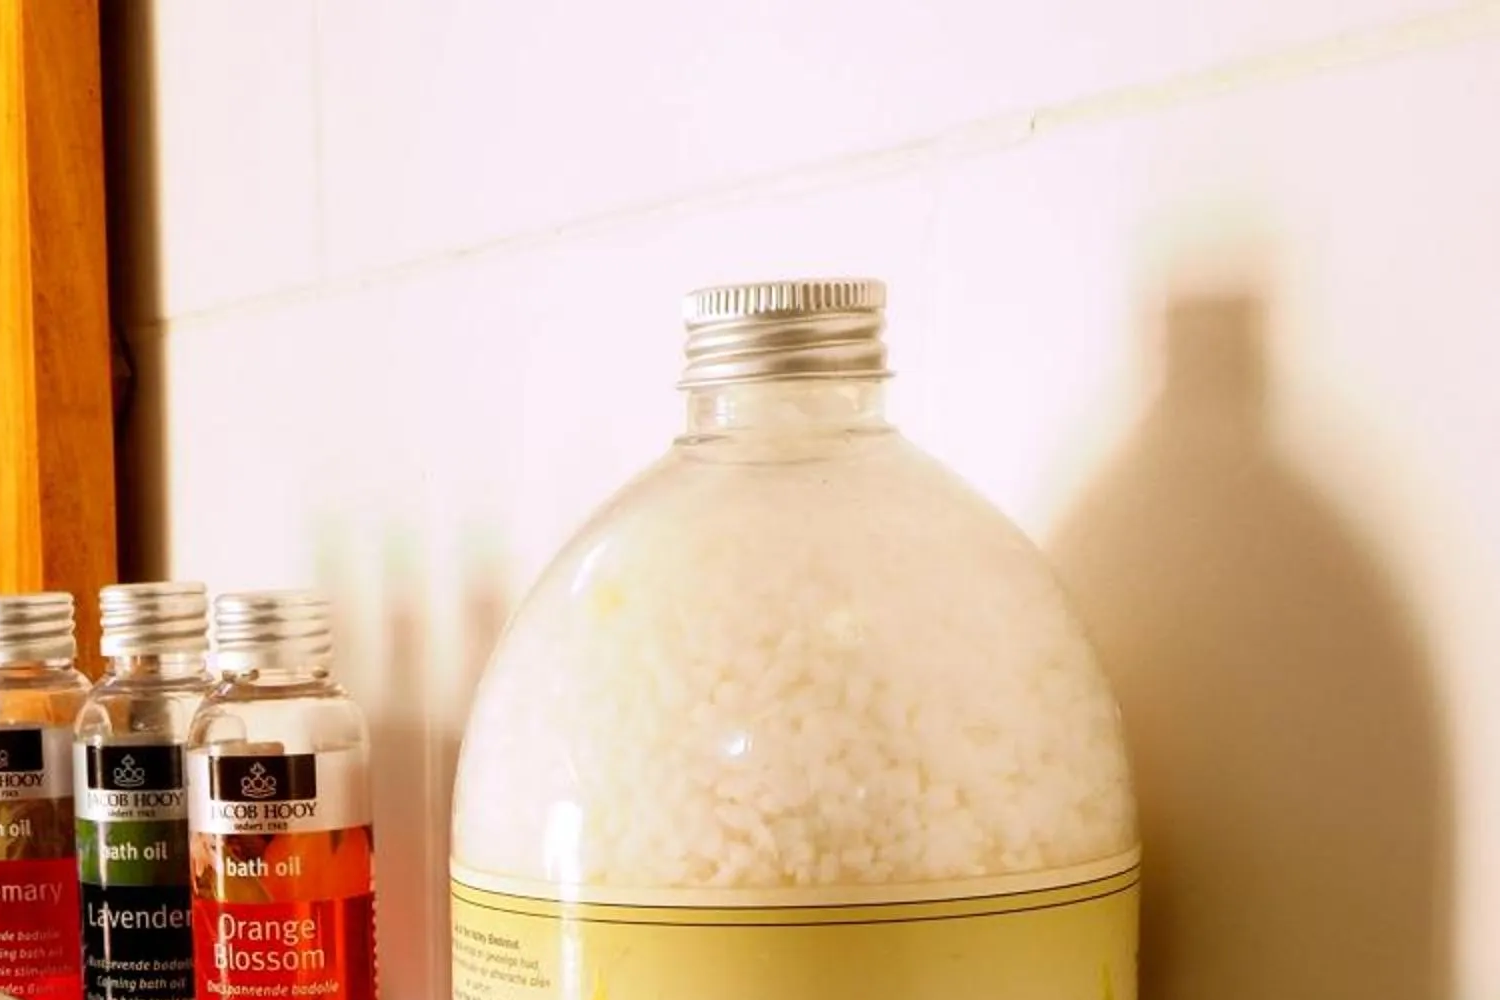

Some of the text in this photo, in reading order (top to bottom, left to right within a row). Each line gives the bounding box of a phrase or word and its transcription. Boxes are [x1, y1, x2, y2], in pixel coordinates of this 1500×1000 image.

[0, 773, 45, 788] HOOY
[134, 791, 184, 807] HOOY
[263, 801, 317, 819] HOOY
[8, 819, 32, 837] oil
[143, 841, 168, 860] oil
[226, 855, 301, 877] bath oil
[87, 901, 193, 929] Lavender
[219, 913, 316, 946] Orange
[214, 943, 325, 971] Blossom
